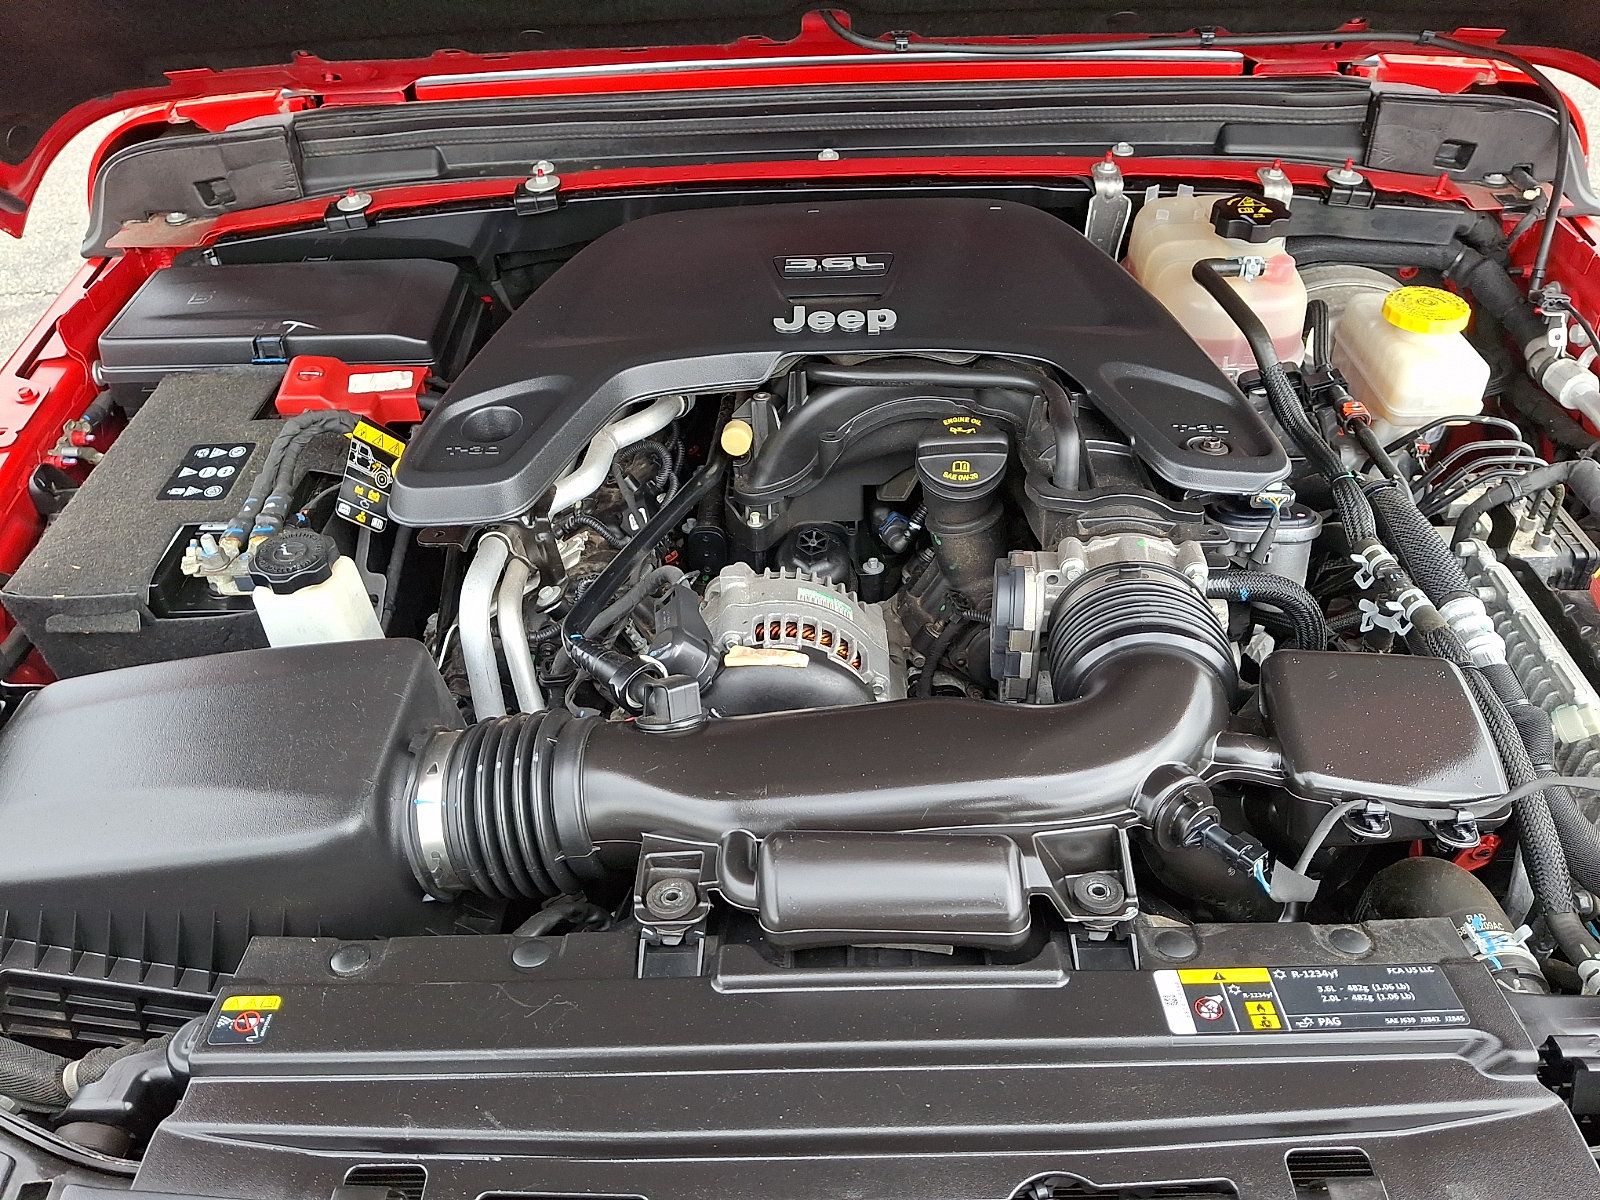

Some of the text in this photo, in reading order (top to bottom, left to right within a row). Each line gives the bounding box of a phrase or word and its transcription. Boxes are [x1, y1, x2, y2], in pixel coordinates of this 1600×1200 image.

[784, 256, 885, 273] 3.6L
[773, 305, 897, 336] Jeep
[943, 417, 970, 426] ENGINE
[943, 472, 957, 480] SAE
[1290, 968, 1339, 980] R-1234yf
[1405, 966, 1418, 974] US
[1419, 965, 1436, 973] LLC
[1316, 985, 1337, 993] 3.6L
[1347, 984, 1370, 993] 482g
[1371, 983, 1395, 992] (1.06
[1320, 994, 1342, 1003] 2.0L
[1351, 994, 1375, 1003] 482g
[1376, 993, 1400, 1002] (1.06
[1317, 1017, 1342, 1027] PAG
